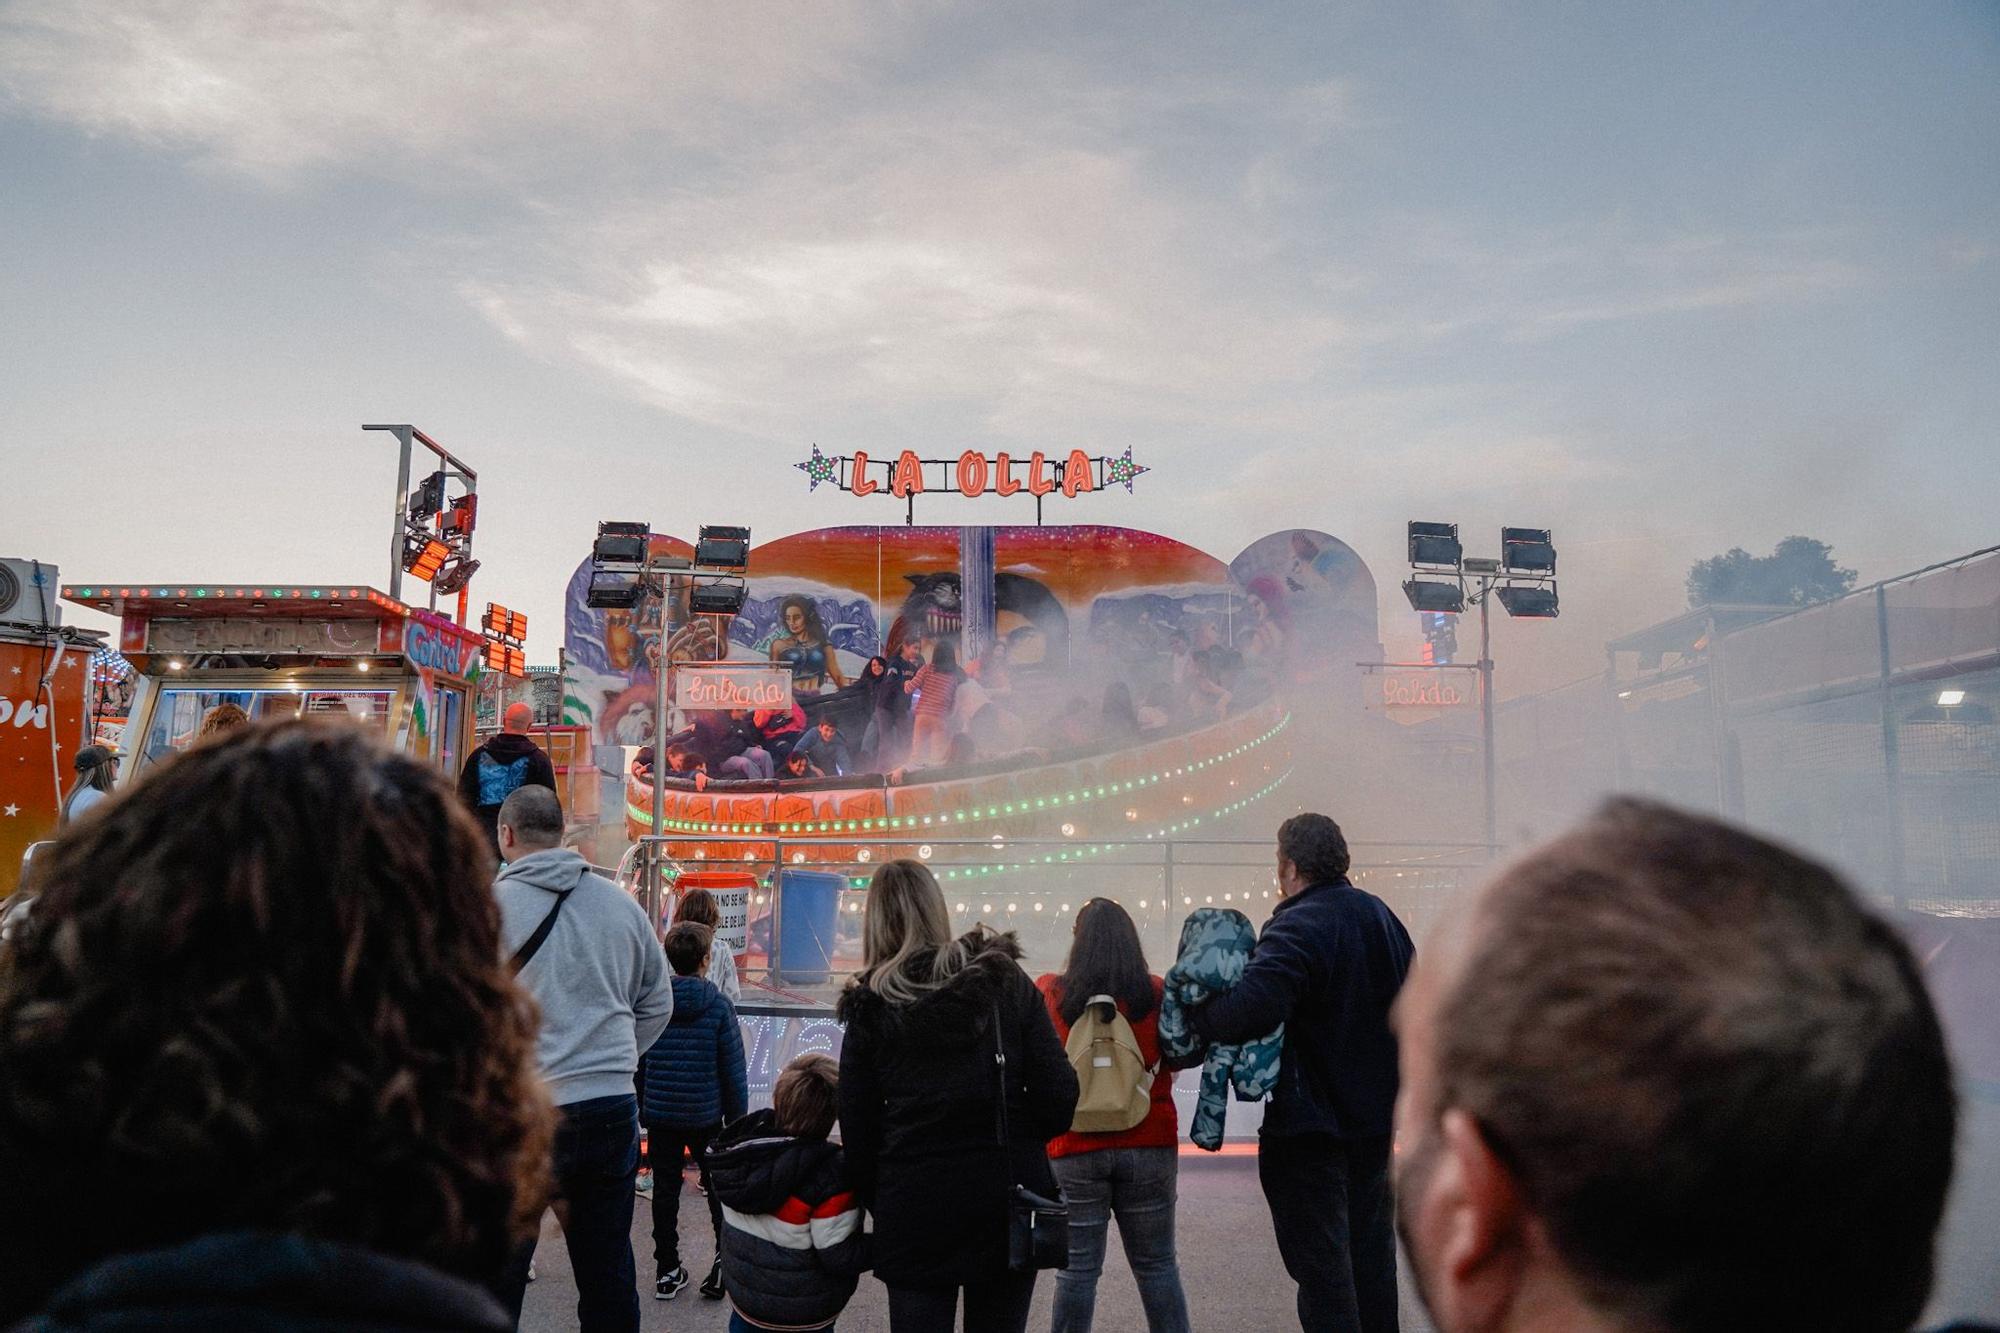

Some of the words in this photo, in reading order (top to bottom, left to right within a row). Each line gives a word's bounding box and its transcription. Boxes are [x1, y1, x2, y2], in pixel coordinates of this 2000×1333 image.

[851, 450, 923, 498] LA
[956, 450, 1094, 498] OLLA
[407, 623, 461, 674] Control
[686, 676, 785, 705] Entrada
[721, 894, 730, 907] NO
[731, 894, 738, 907] SE
[730, 915, 737, 929] DE
